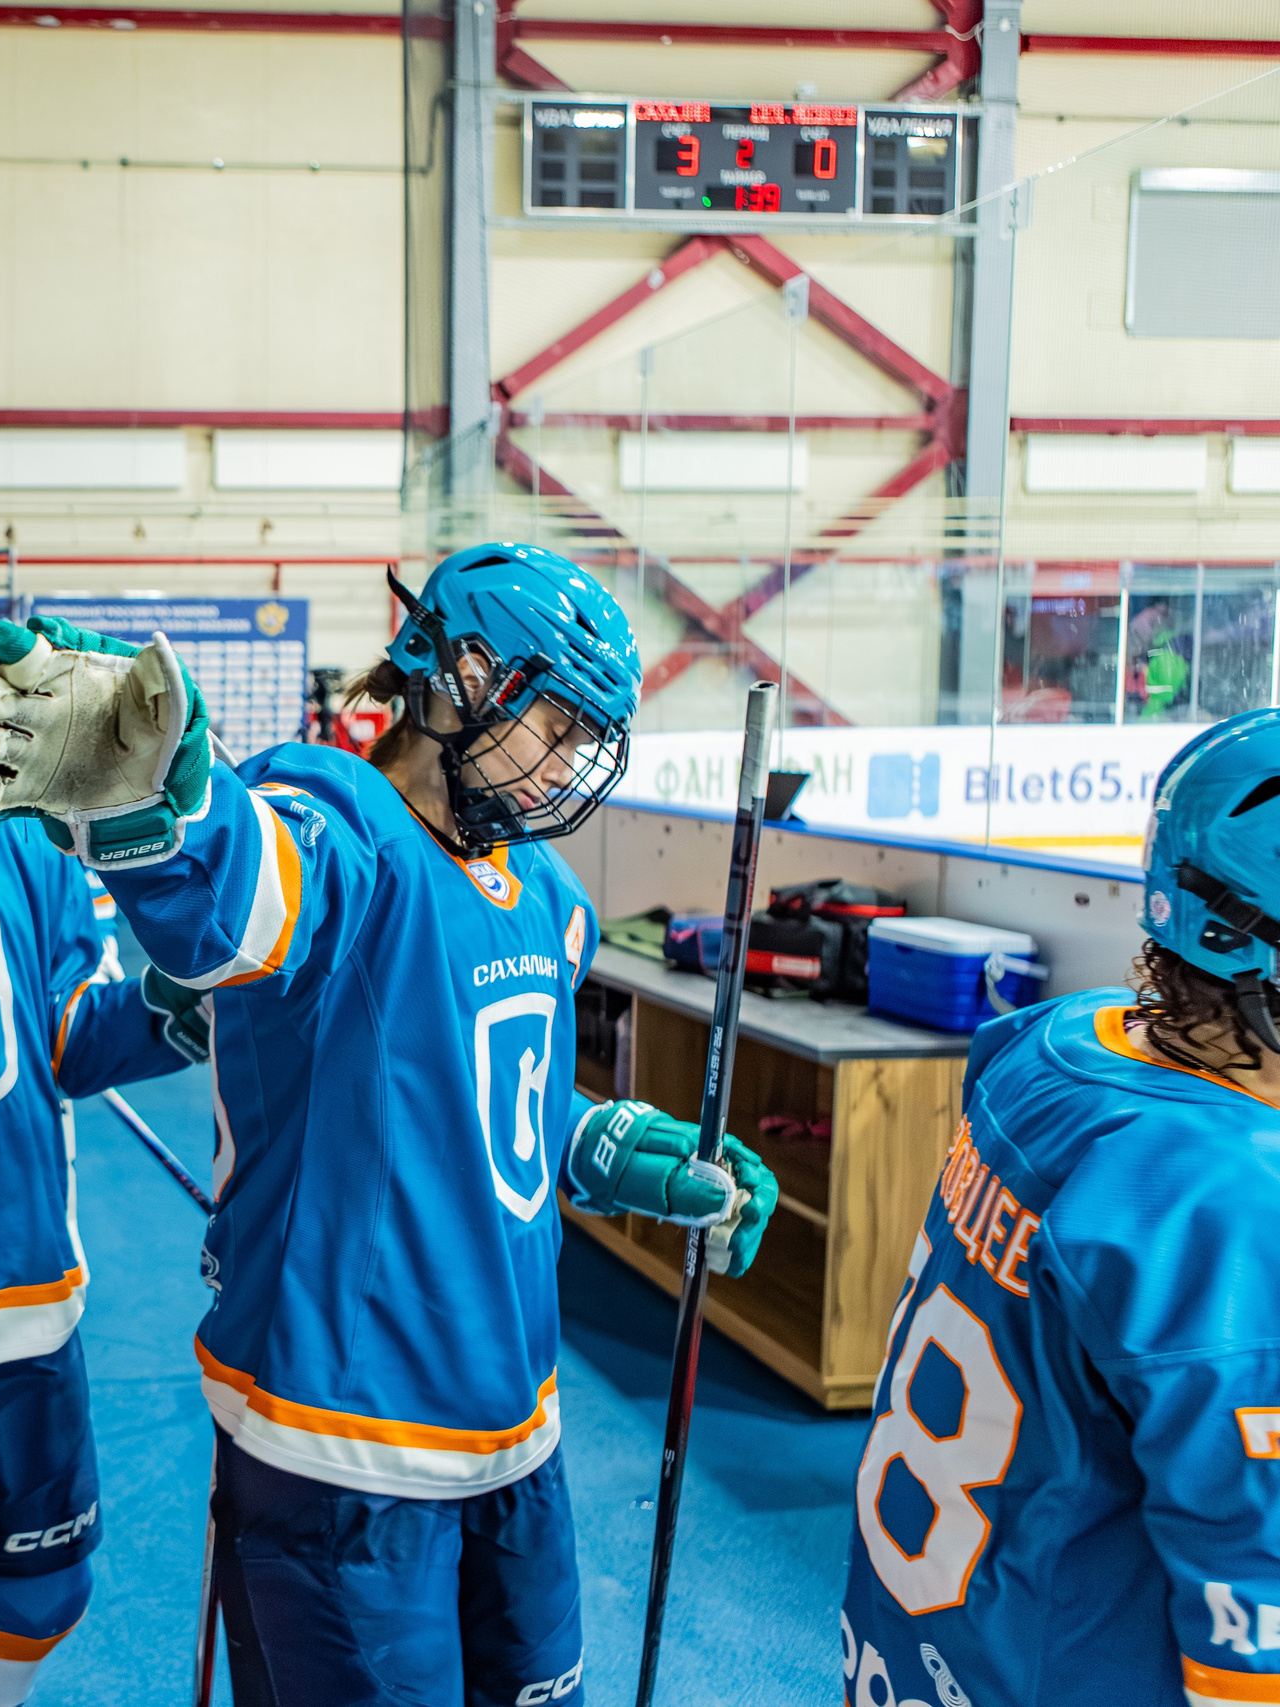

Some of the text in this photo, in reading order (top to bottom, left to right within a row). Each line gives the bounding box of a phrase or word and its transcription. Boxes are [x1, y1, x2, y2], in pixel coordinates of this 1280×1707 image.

[677, 135, 700, 176] 3
[735, 139, 754, 169] 2
[813, 138, 837, 179] 0
[473, 955, 558, 987] САХАЛИН
[685, 1225, 700, 1278] AUER
[3, 1500, 98, 1554] CCM
[515, 1646, 584, 1707] CC
